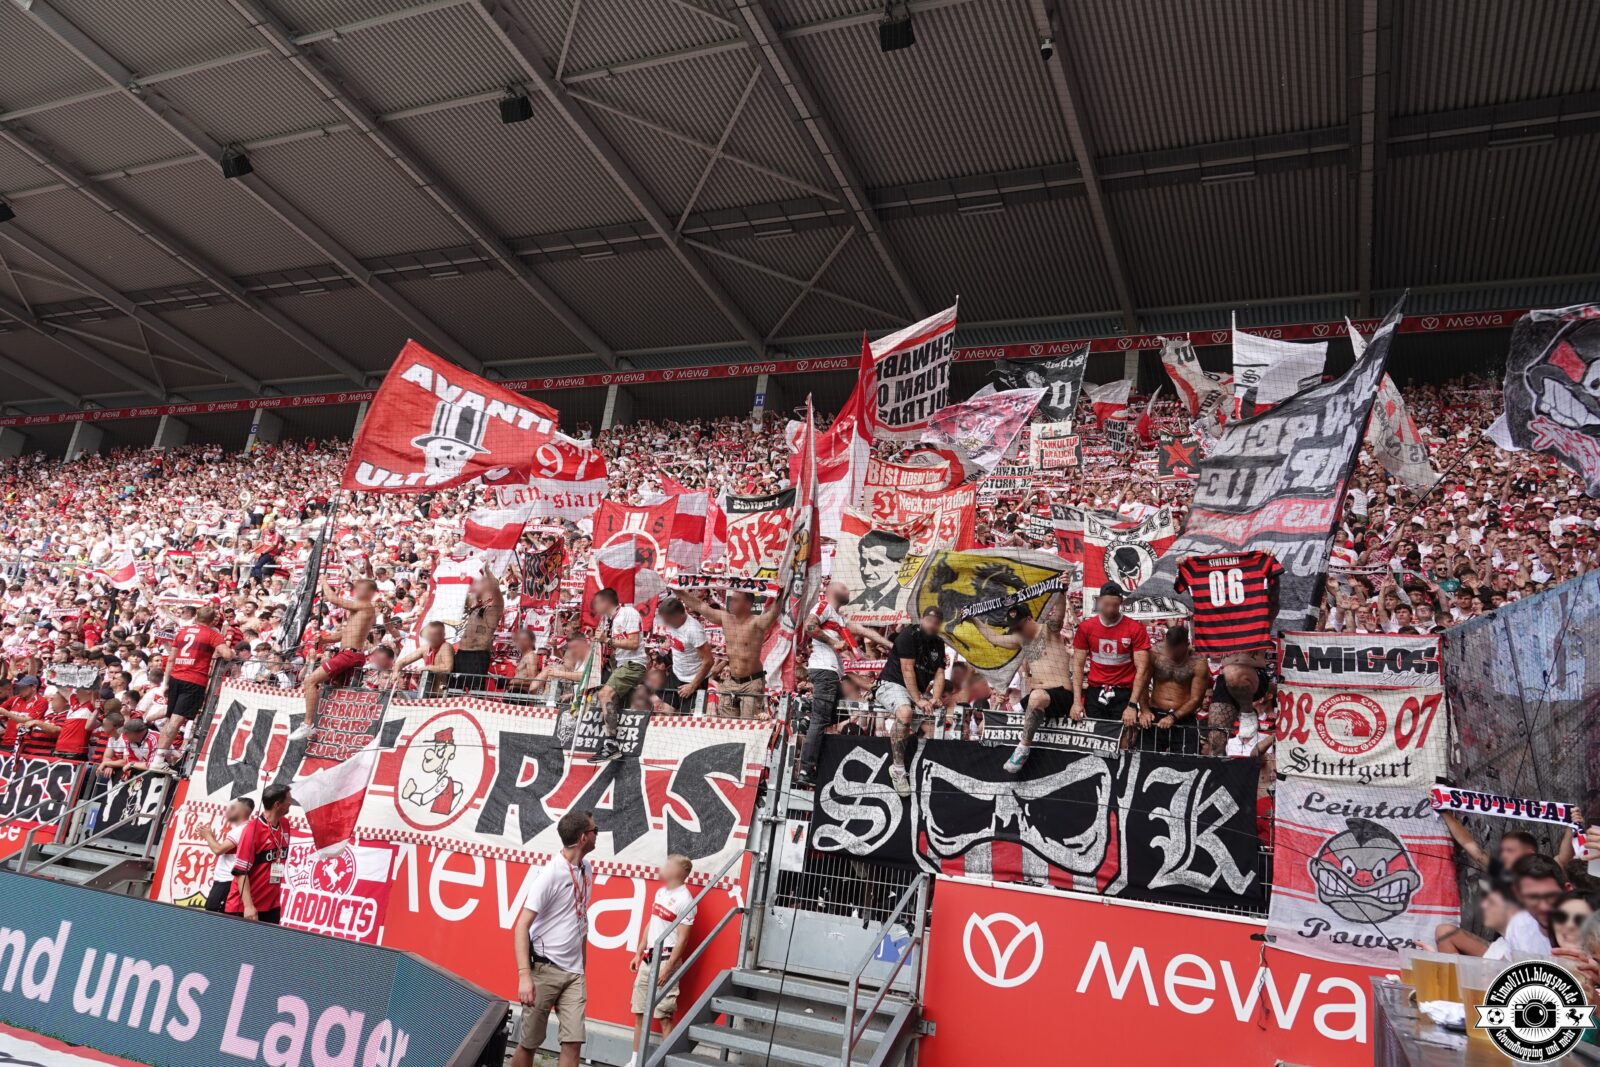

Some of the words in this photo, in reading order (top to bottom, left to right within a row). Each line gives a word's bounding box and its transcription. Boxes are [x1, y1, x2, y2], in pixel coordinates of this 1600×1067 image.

[401, 361, 553, 435] AVANTI
[868, 460, 899, 486] Bist
[991, 465, 1034, 477] CHWABEN
[1208, 556, 1241, 568] STUTTGART
[1208, 567, 1246, 608] 06
[180, 633, 196, 657] 2
[328, 689, 380, 703] JEDER
[317, 699, 384, 720] VERBANNTE
[319, 716, 372, 733] KEHRT
[1047, 717, 1097, 733] ALLEN
[984, 728, 1070, 745] VERSTOBENEN
[1071, 734, 1118, 752] ULTRAS
[1282, 746, 1412, 785] Stuttgart
[1297, 791, 1431, 820] Leintal
[290, 890, 374, 933] ADDICTS
[73, 947, 210, 1042] ums
